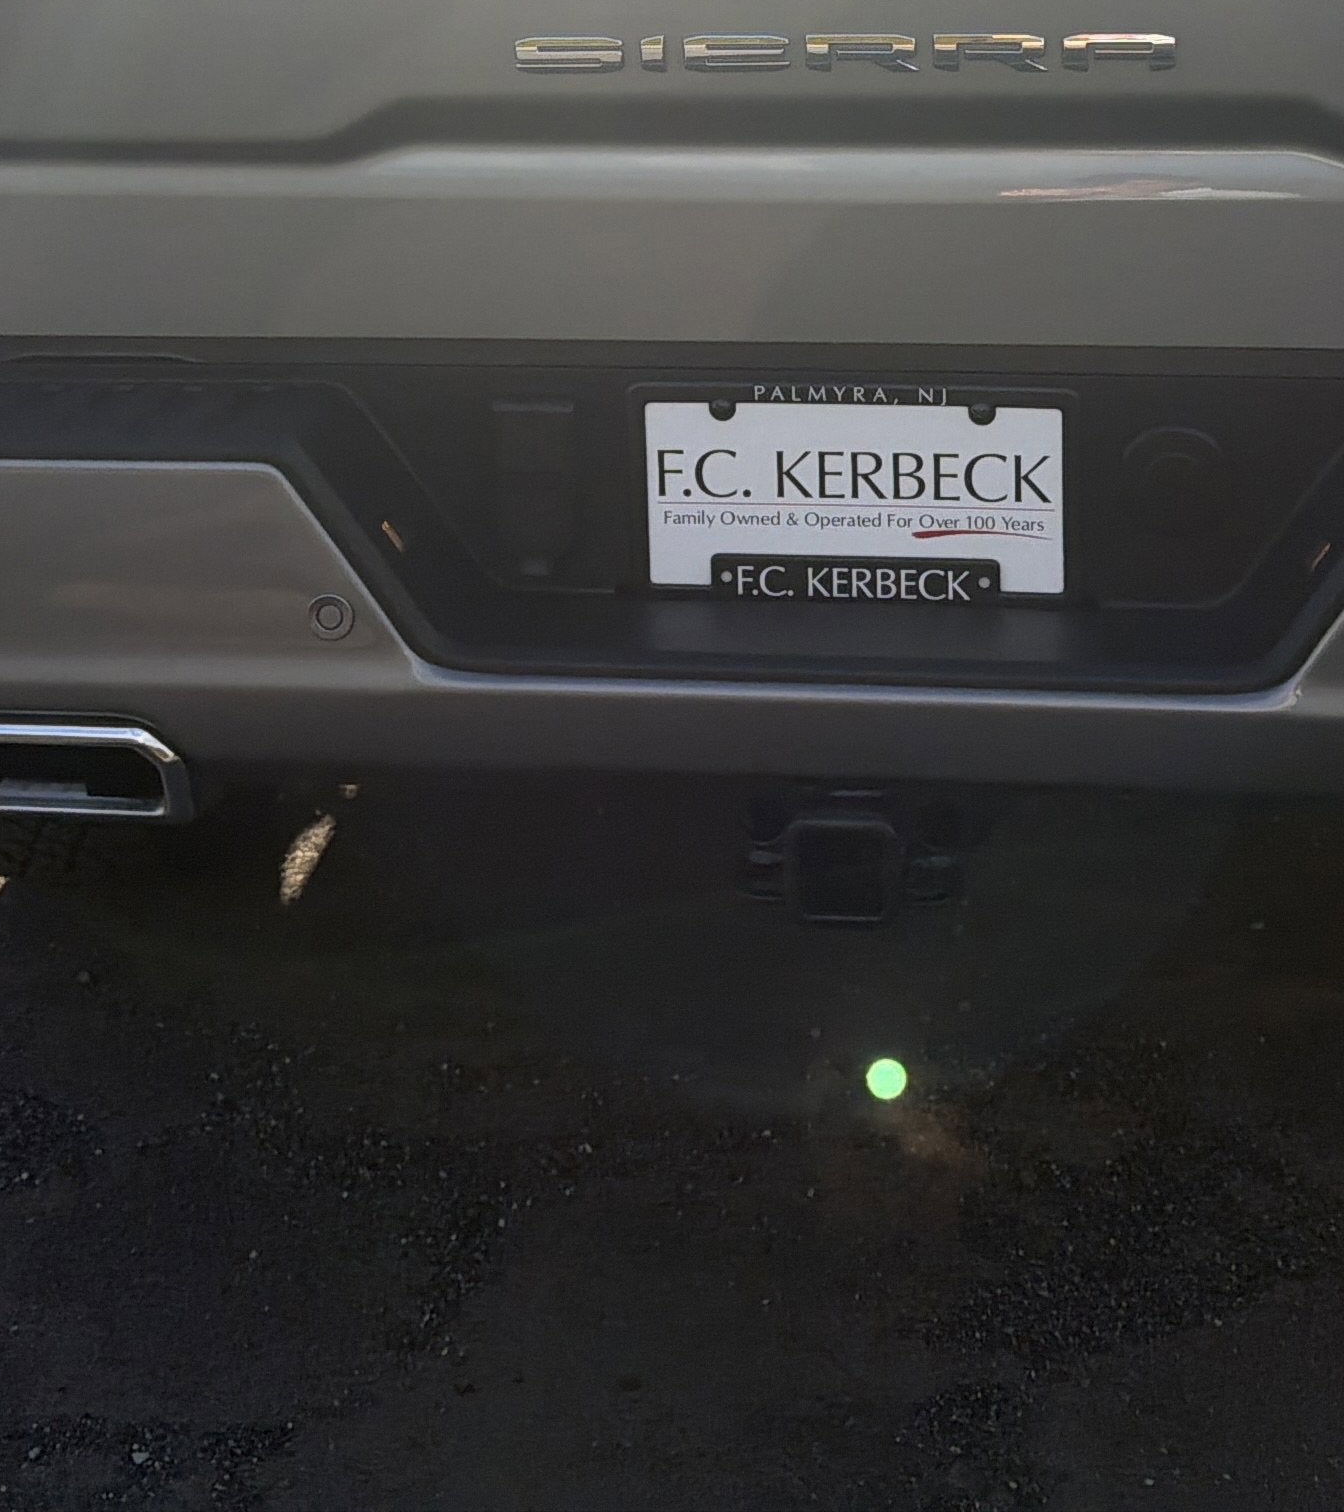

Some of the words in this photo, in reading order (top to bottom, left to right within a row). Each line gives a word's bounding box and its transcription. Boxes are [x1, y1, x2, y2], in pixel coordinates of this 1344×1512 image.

[513, 32, 1178, 73] SIERRA
[753, 385, 899, 405] PALMYRA,
[917, 387, 948, 406] NJ
[657, 449, 753, 498] F.C.
[776, 450, 1052, 504] KERBECK
[663, 509, 716, 529] Family
[719, 510, 782, 526] Owned
[786, 512, 799, 527] &
[804, 511, 882, 530] Operated
[886, 514, 913, 529] For
[918, 514, 960, 529] Over
[966, 515, 996, 531] 100
[1001, 516, 1045, 532] Years
[736, 565, 795, 597] F.C.
[807, 567, 971, 601] KERBECK
